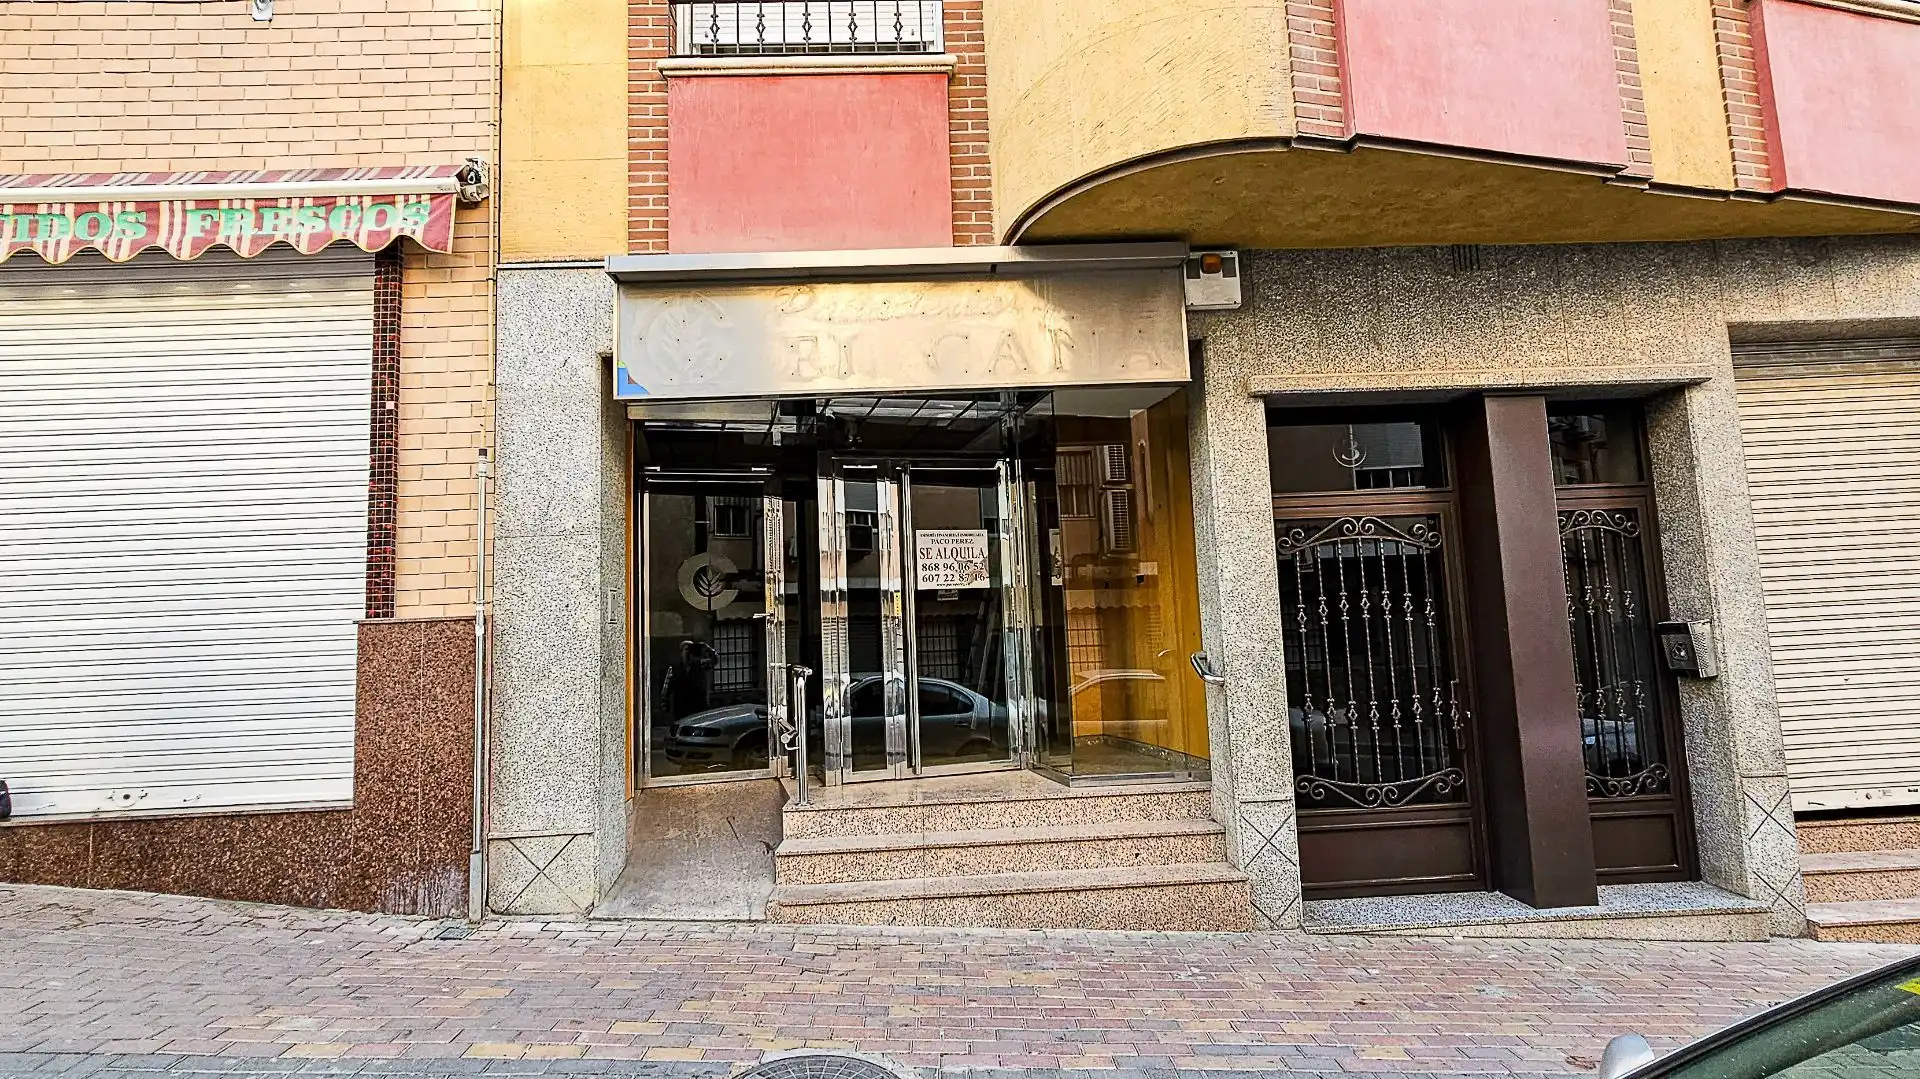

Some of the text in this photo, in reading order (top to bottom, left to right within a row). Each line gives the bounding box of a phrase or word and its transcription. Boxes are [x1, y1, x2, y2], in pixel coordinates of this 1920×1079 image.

[0, 202, 431, 242] IDOS FRESCOS
[920, 547, 985, 561] SE ALQUILA
[921, 562, 940, 572] 868
[942, 562, 955, 572] 96
[974, 562, 984, 570] 52
[922, 573, 940, 583] 607
[943, 573, 956, 583] 22
